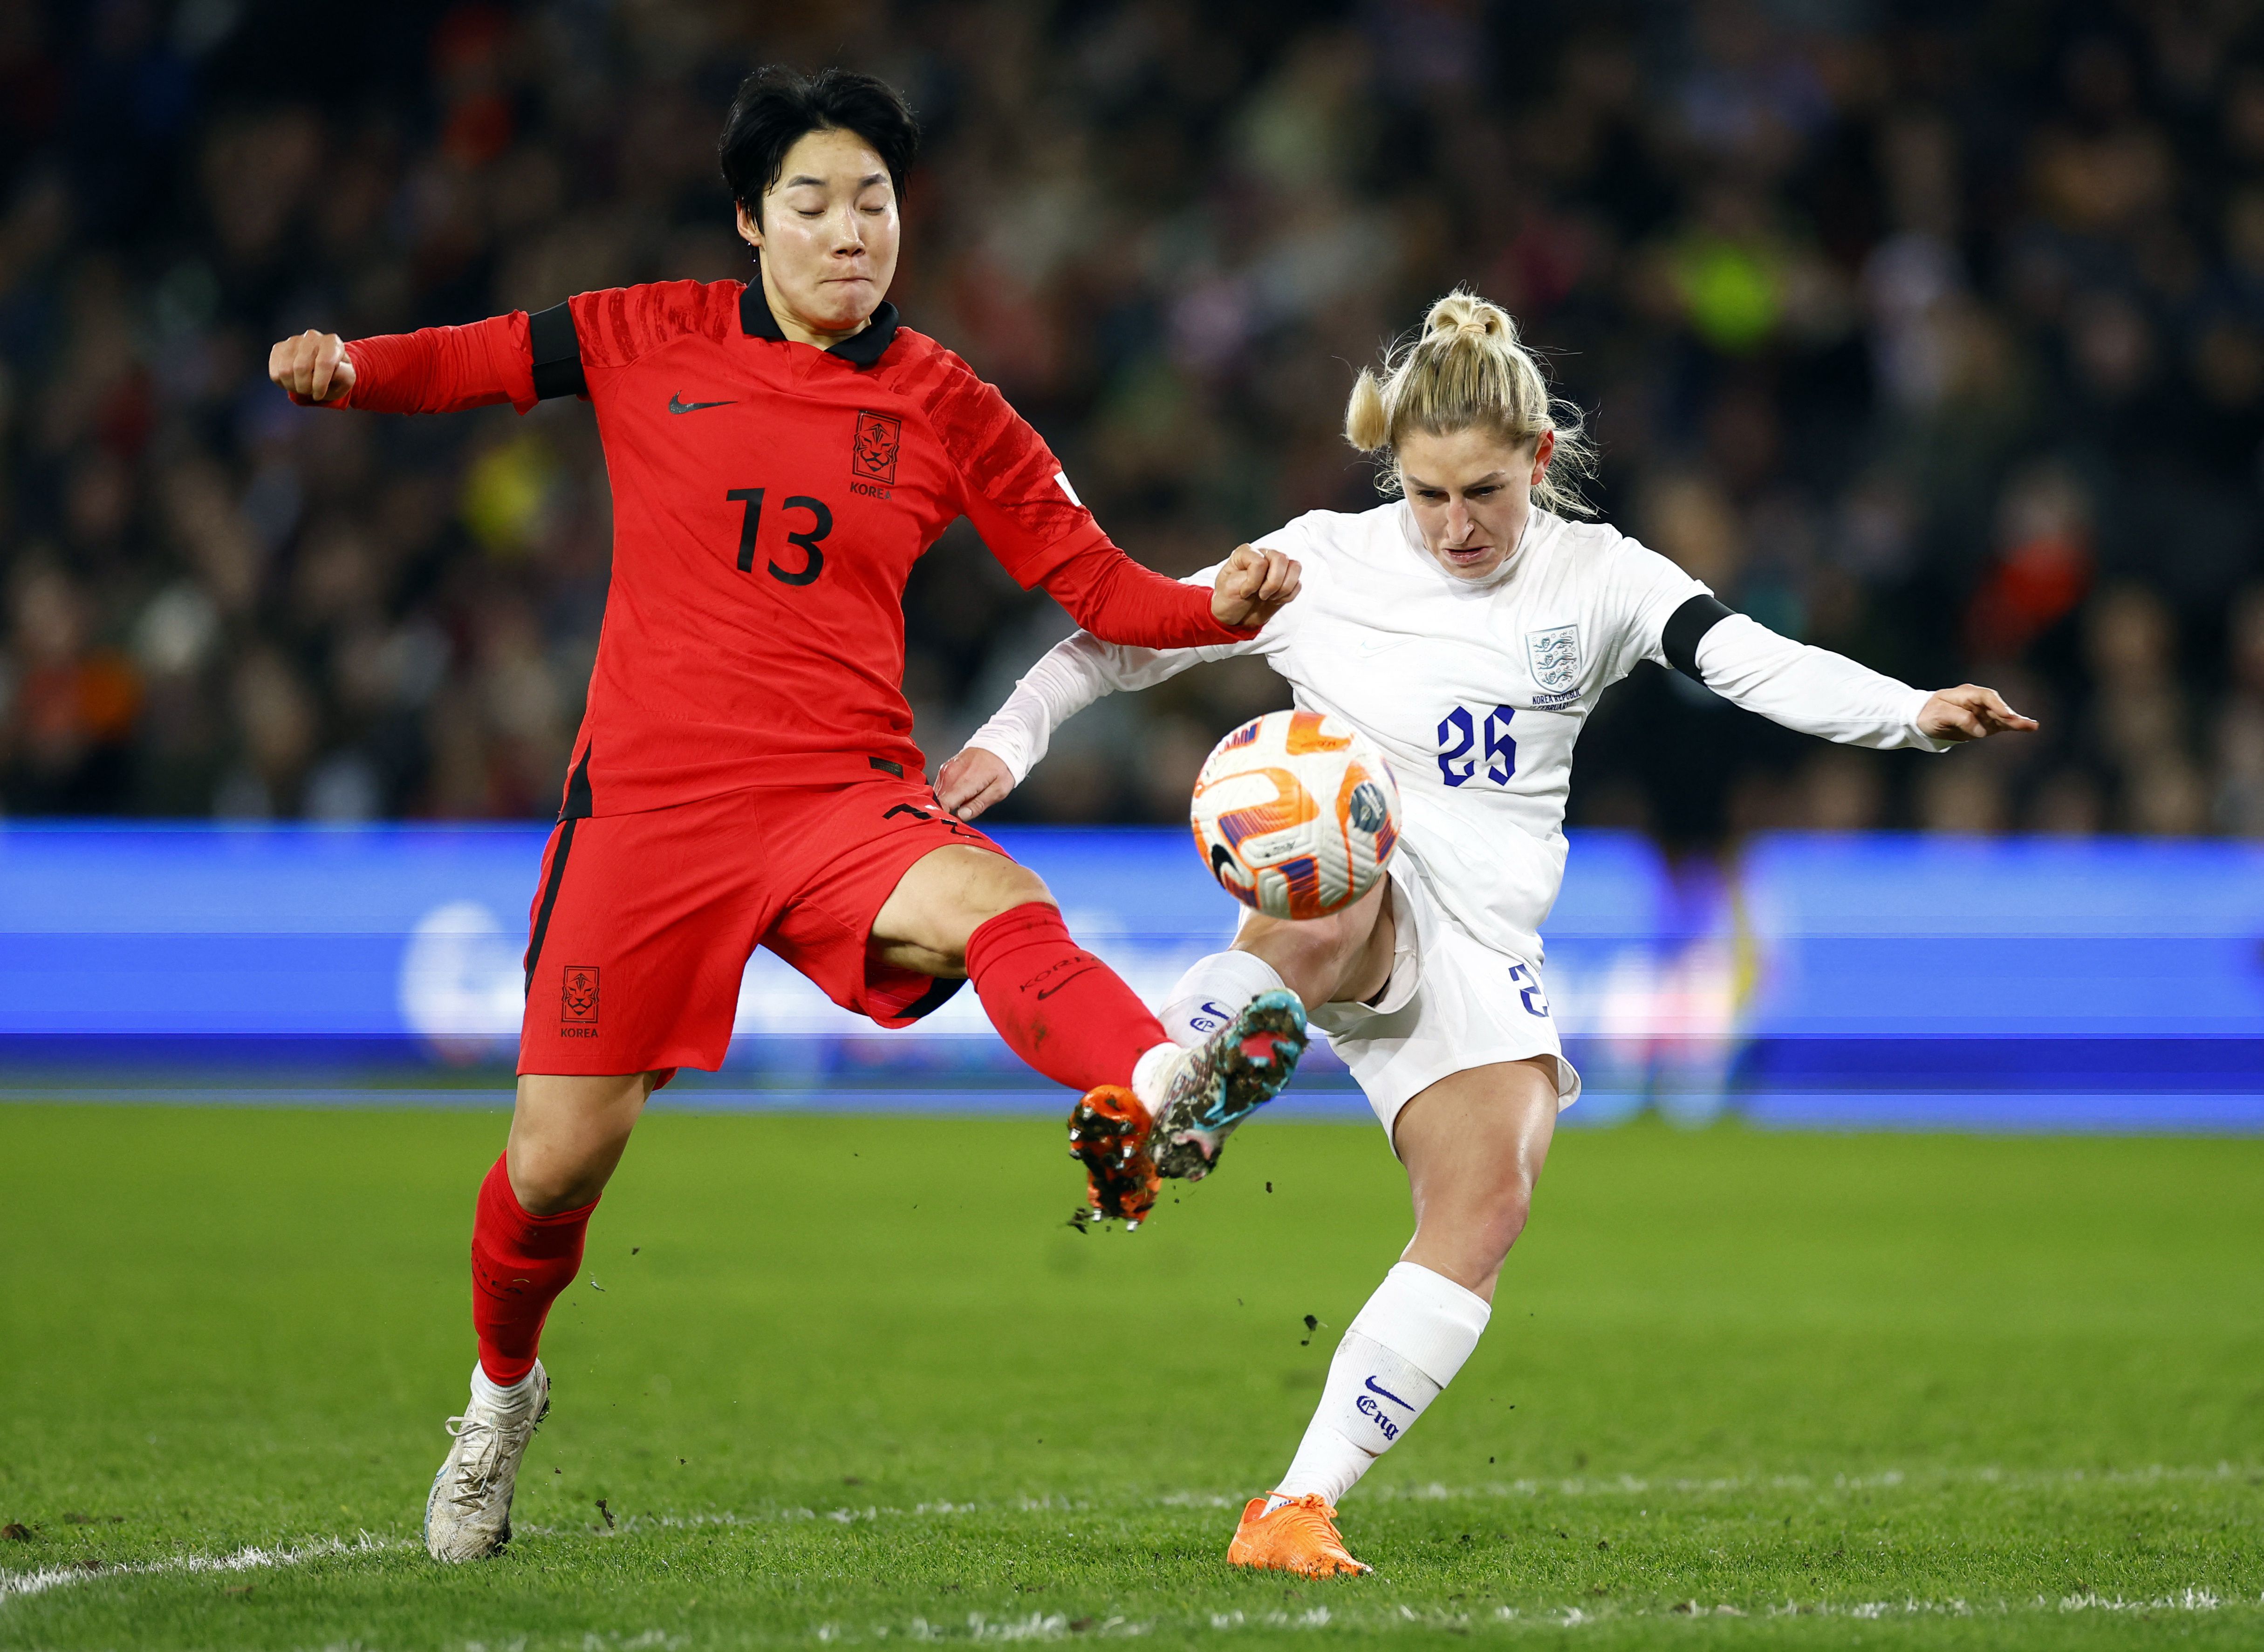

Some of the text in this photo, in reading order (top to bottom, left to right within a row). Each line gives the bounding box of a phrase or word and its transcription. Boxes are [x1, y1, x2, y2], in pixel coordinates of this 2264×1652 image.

[850, 481, 892, 501] KOREA
[726, 488, 833, 586] 13
[1532, 688, 1581, 704] KOREA REPUBLIC
[561, 1028, 599, 1038] KOREA
[1356, 1395, 1399, 1440] Eng
